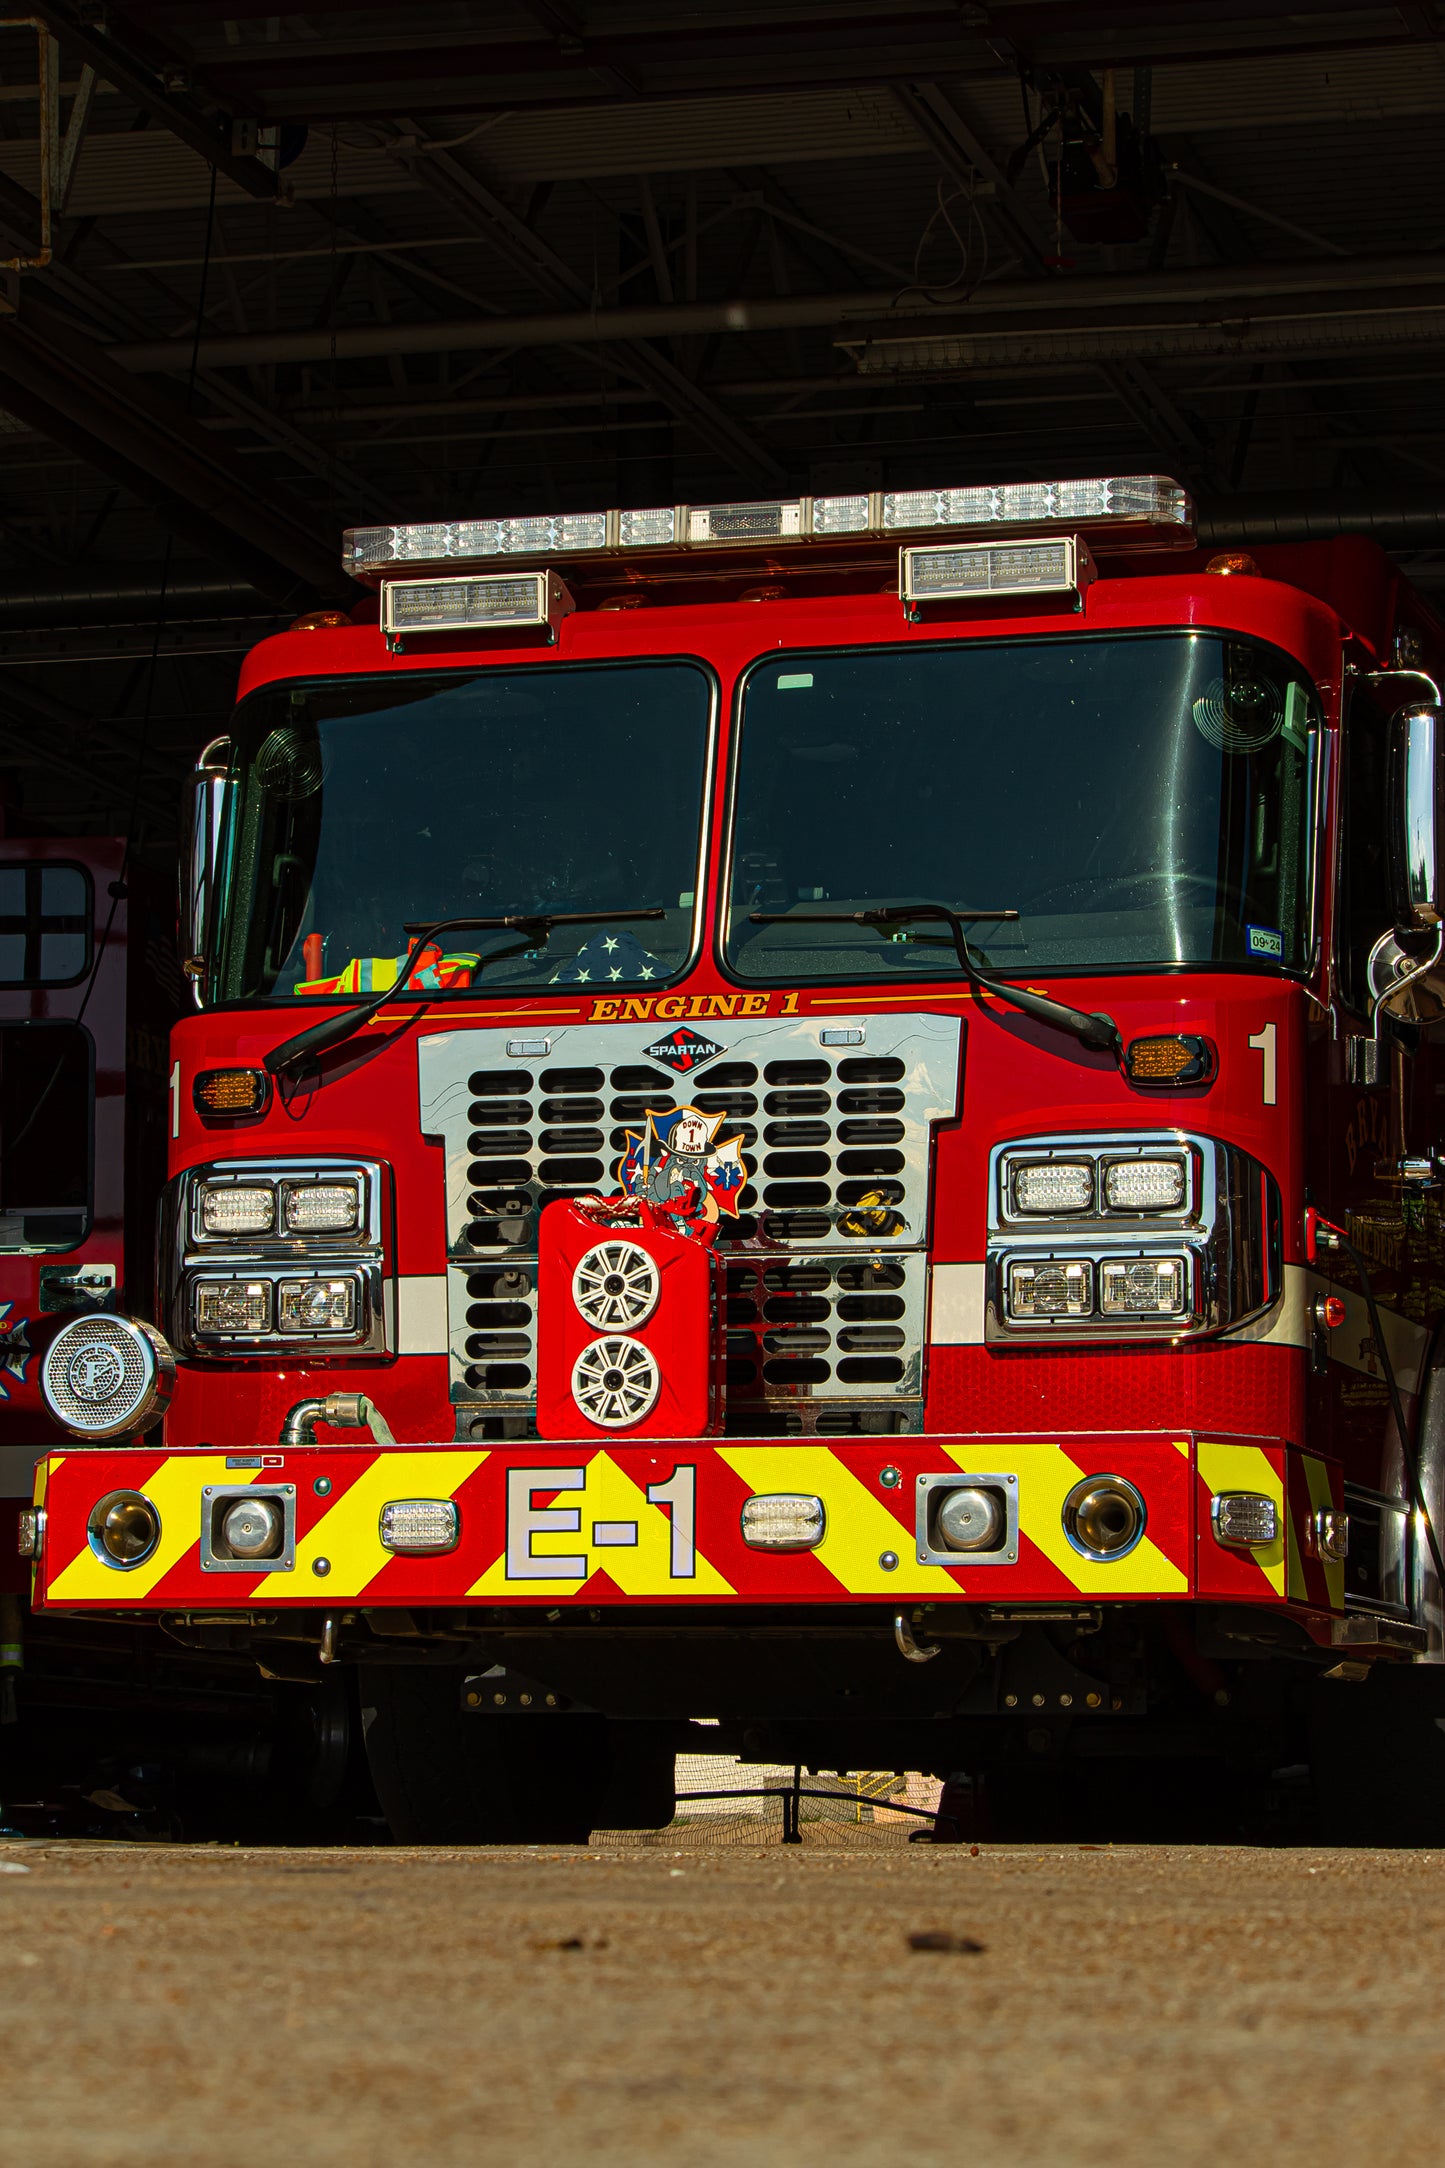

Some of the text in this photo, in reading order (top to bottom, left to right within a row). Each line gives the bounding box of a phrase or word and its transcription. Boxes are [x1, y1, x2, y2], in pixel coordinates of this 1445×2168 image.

[587, 992, 800, 1021] ENGINE 1
[649, 1043, 717, 1056] SPARTAN
[1248, 1022, 1277, 1106] 1
[169, 1060, 180, 1139] 1
[682, 1120, 703, 1130] DOWN
[688, 1129, 695, 1143] 1
[681, 1142, 702, 1152] TOWN
[505, 1463, 697, 1581] E-1
